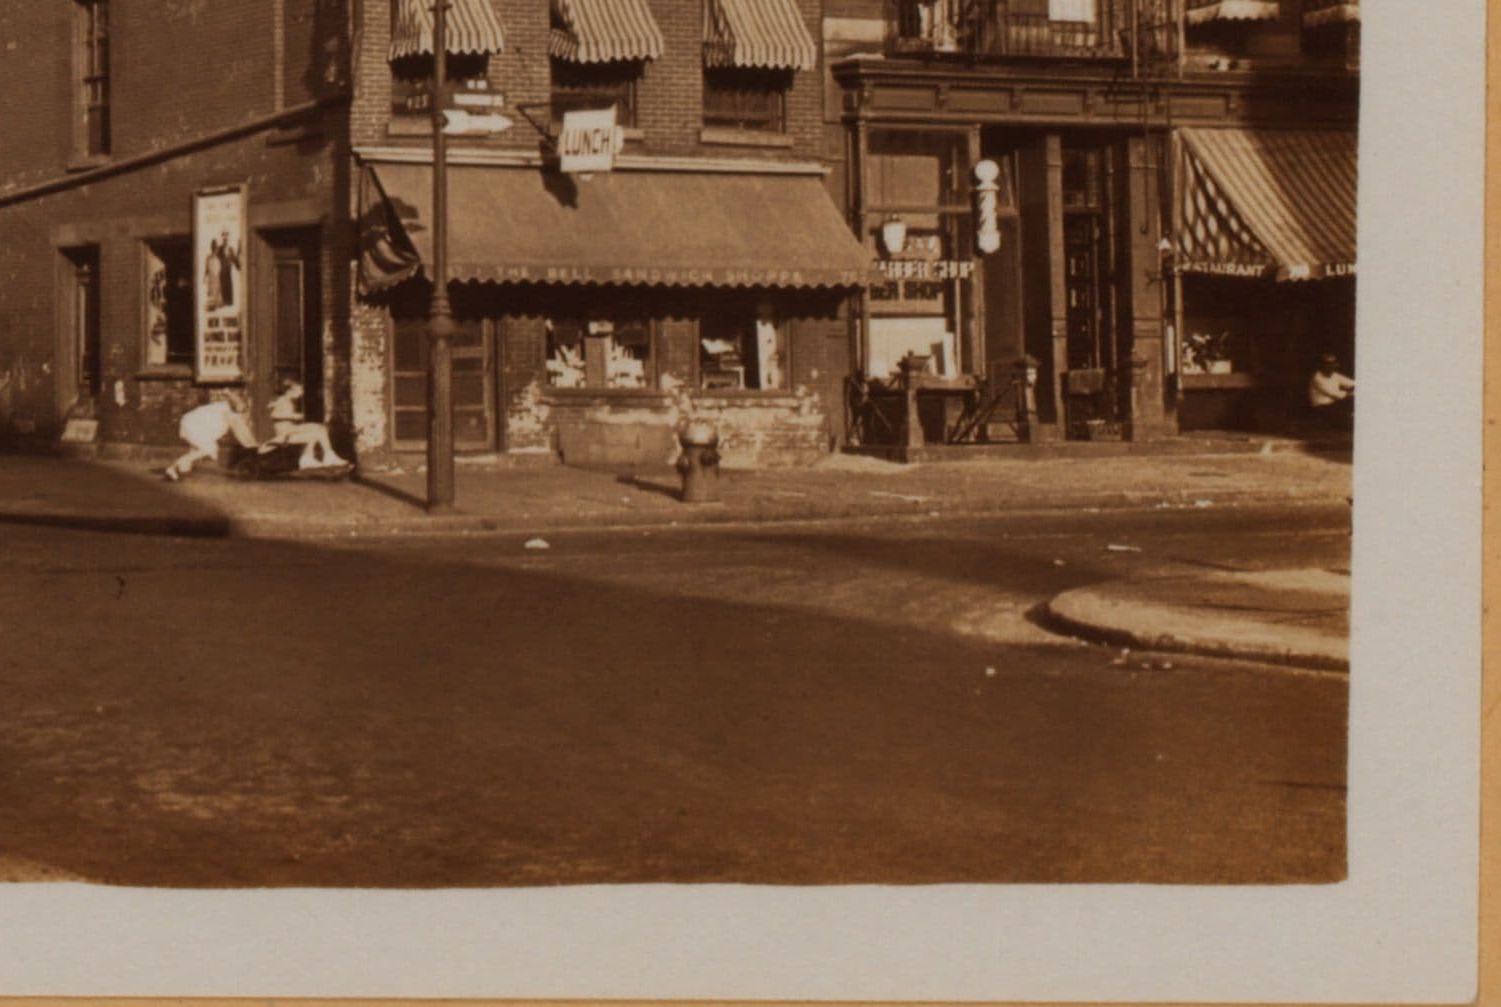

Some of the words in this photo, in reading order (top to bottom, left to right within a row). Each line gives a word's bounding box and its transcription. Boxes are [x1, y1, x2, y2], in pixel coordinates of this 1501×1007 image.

[564, 128, 611, 157] LUNCH
[547, 265, 593, 279] BELL
[611, 267, 713, 281] SANDWICH
